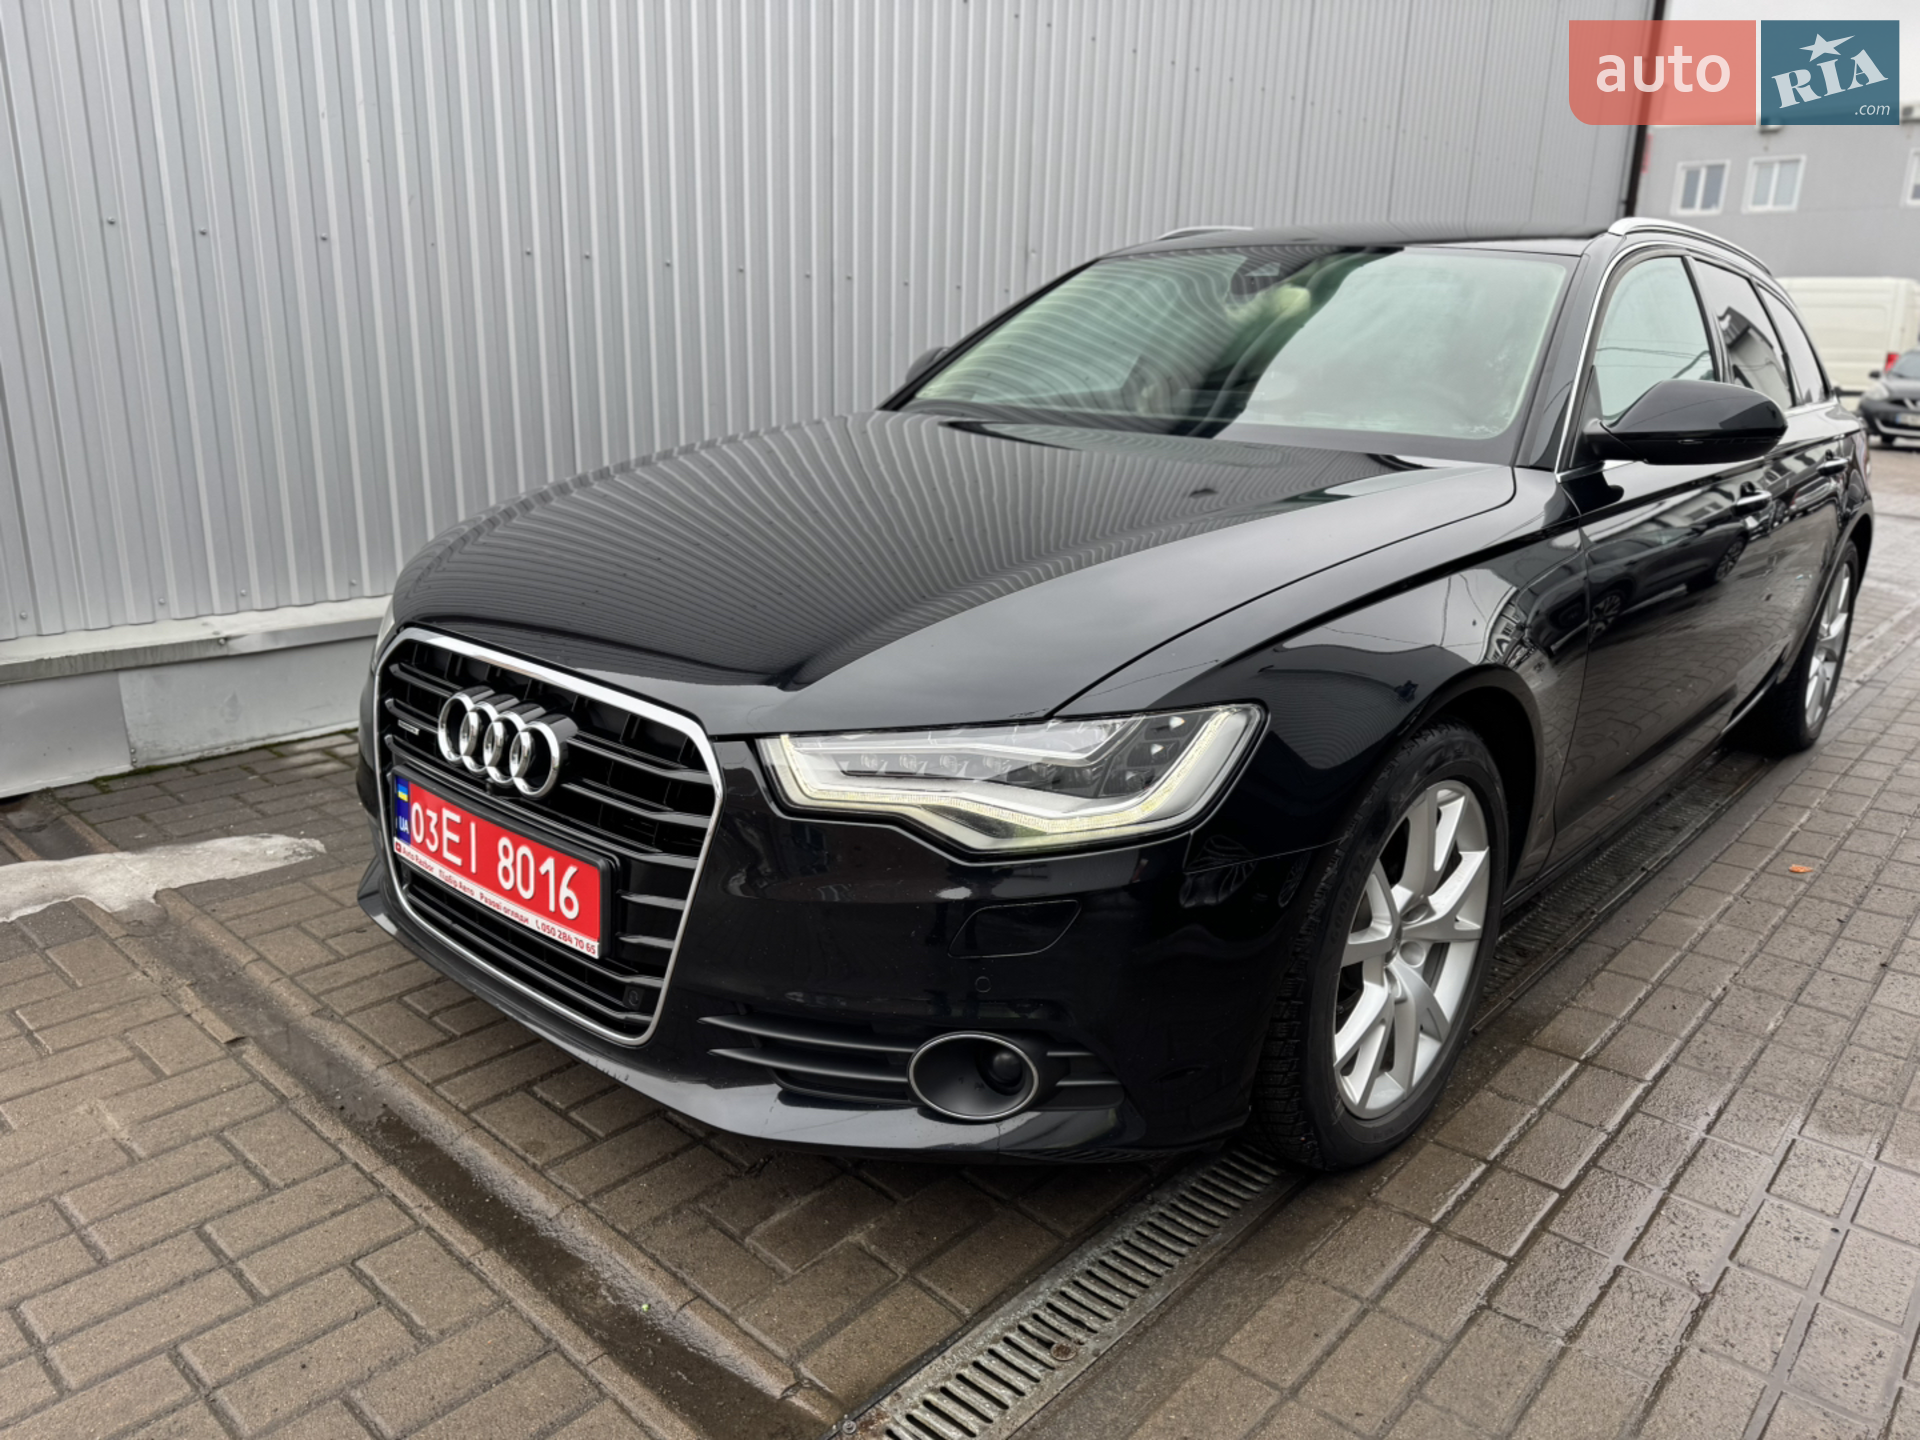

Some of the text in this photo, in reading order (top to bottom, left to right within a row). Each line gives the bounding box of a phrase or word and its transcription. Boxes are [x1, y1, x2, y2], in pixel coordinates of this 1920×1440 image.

[398, 815, 410, 834] UA
[411, 802, 580, 920] 03EI 8016
[541, 922, 597, 955] 050 284 70 65
